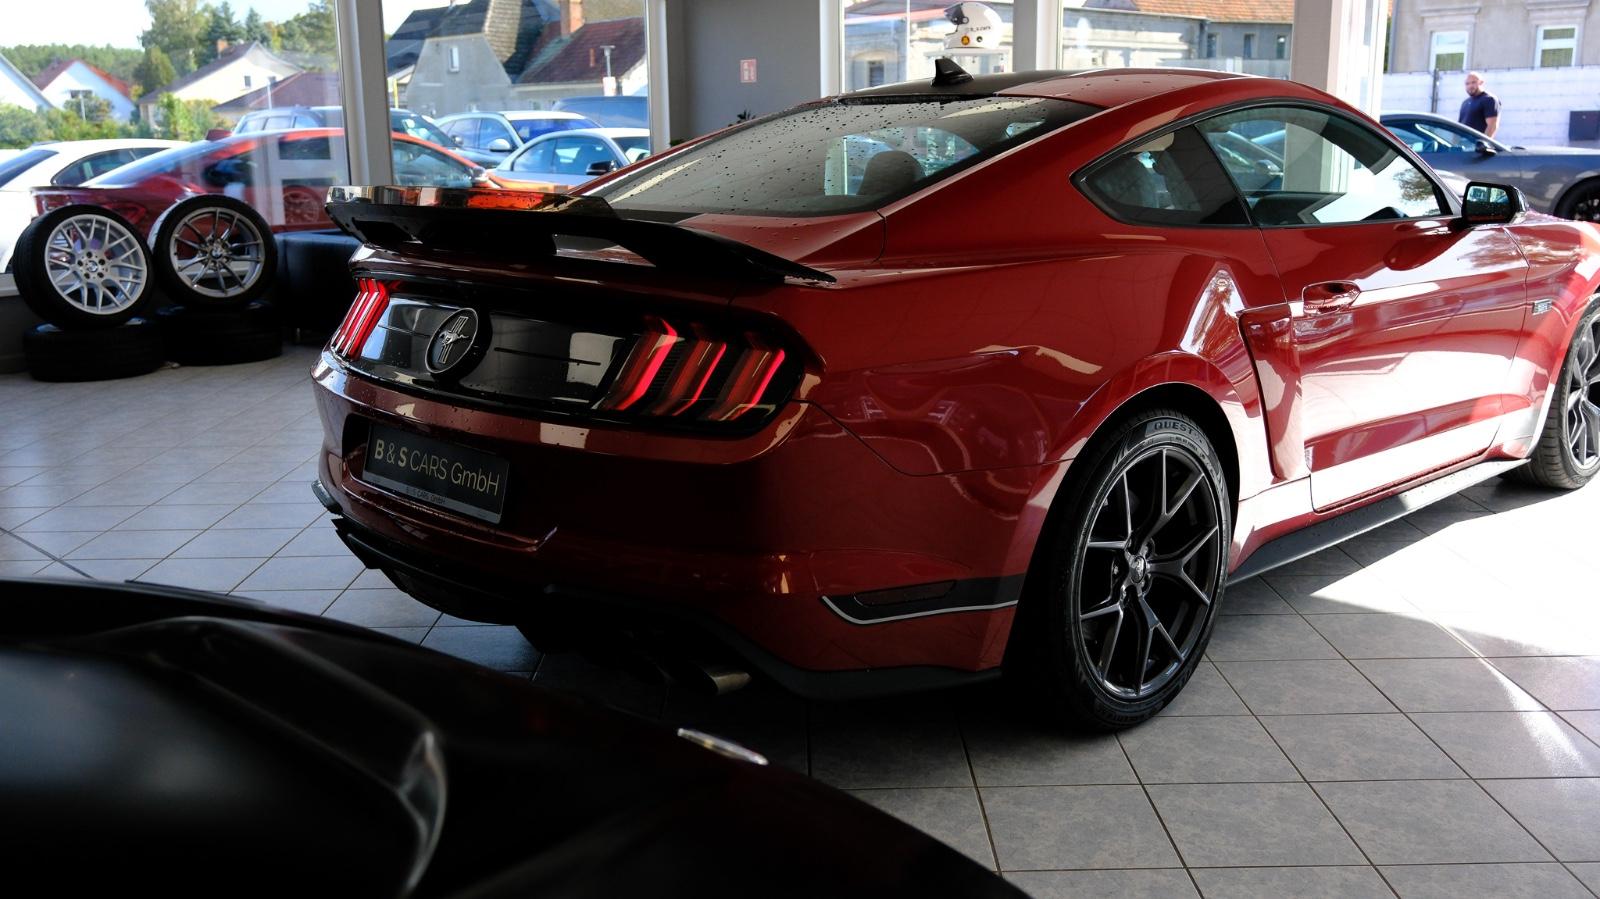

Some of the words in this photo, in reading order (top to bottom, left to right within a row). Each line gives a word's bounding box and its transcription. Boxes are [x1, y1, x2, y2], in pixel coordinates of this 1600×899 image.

[375, 439, 385, 460] B
[386, 442, 395, 465] &
[398, 446, 408, 468] S
[409, 450, 449, 480] CARS
[451, 462, 500, 496] GmbH
